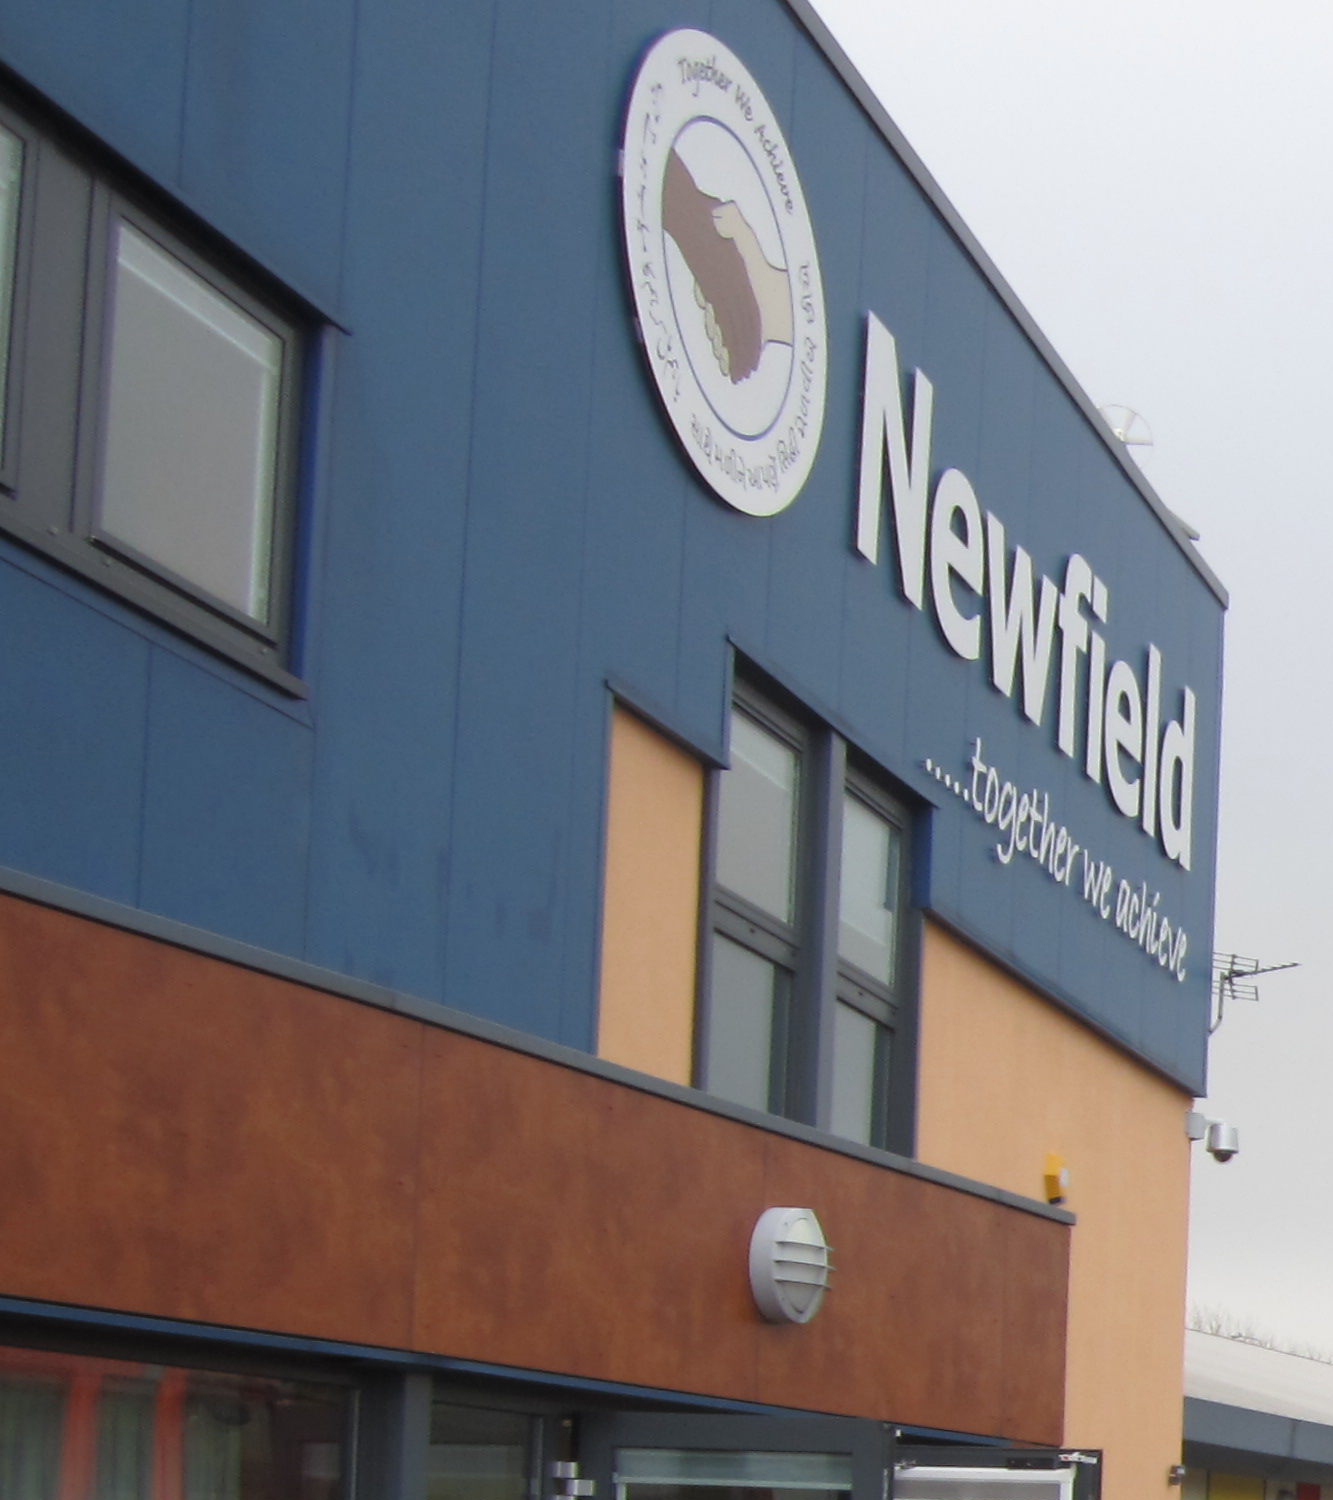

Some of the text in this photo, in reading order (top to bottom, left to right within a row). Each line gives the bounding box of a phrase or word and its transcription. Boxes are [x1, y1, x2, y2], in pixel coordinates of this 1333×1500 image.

[678, 55, 794, 215] Together We Achieve
[856, 310, 1195, 871] Newfield
[1084, 849, 1112, 919] we
[1116, 879, 1187, 982] achieve
